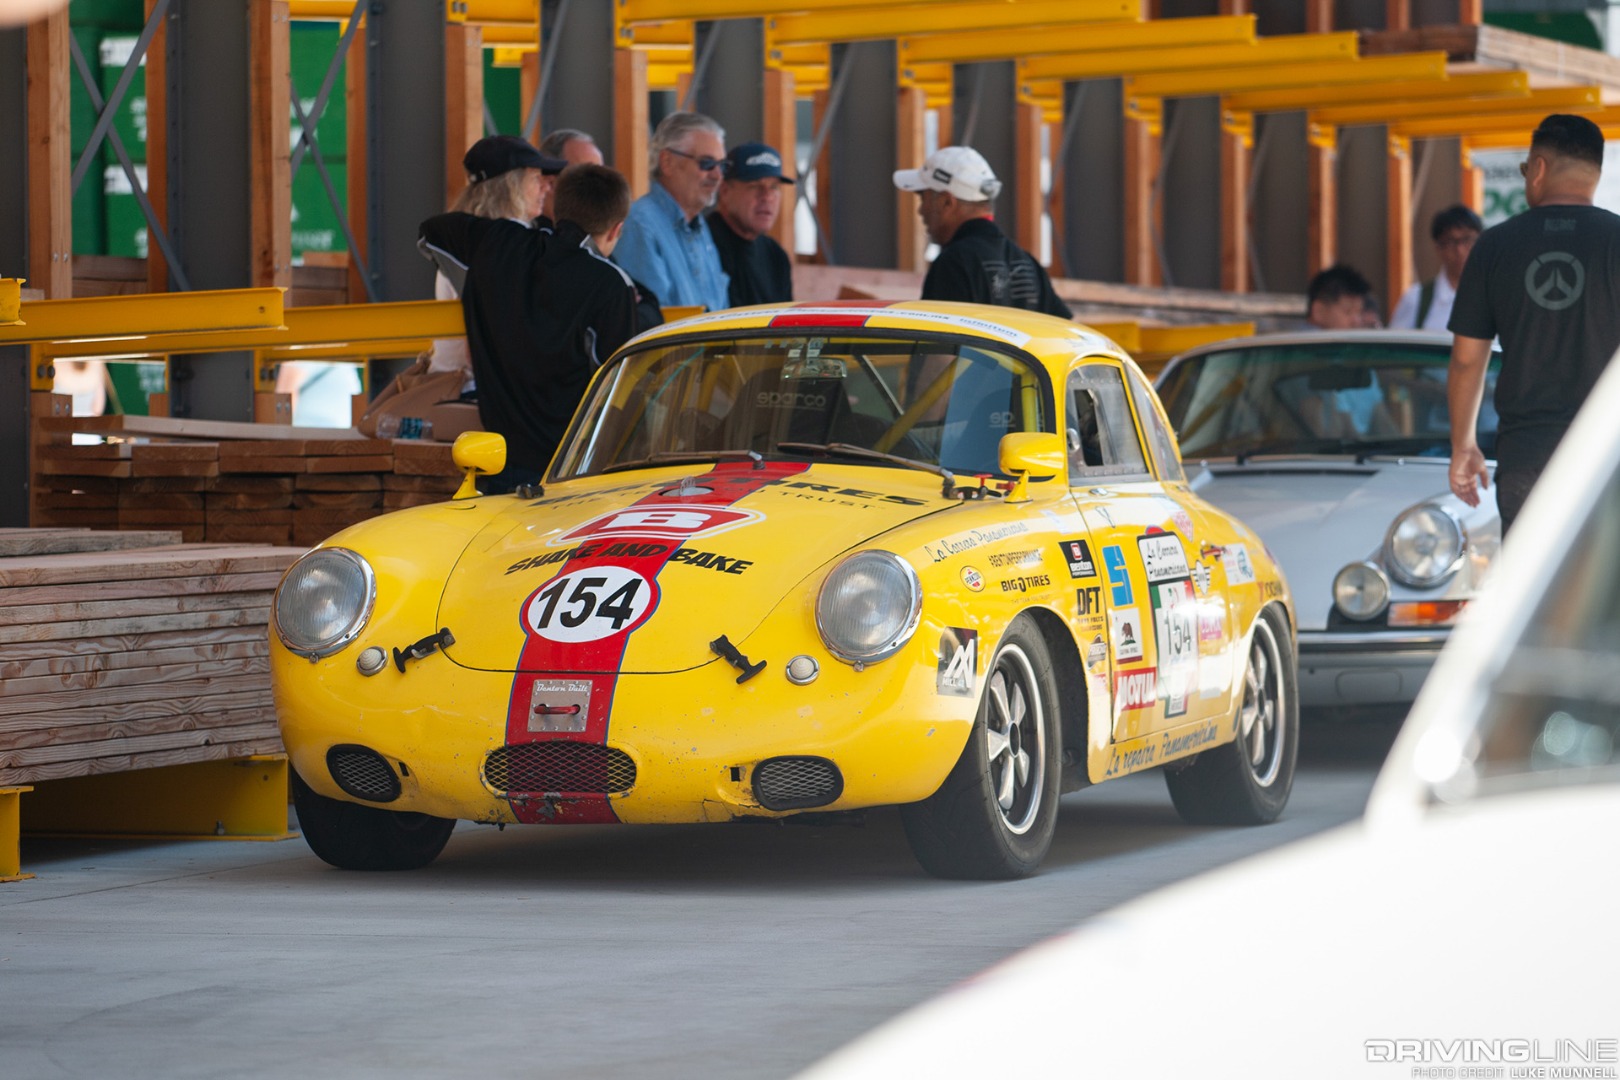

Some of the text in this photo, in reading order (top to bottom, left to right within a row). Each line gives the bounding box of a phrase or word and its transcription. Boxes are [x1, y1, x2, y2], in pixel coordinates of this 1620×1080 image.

[757, 391, 827, 408] sparco
[779, 490, 875, 509] TRUST
[504, 542, 753, 575] SHAKE AND BAKE
[1001, 579, 1018, 592] BIG
[1025, 574, 1051, 588] TIRES
[537, 577, 643, 630] 154
[1077, 586, 1101, 616] DFT
[1164, 611, 1192, 656] 154
[536, 683, 588, 692] Benton Built
[1117, 672, 1156, 705] MOTUL
